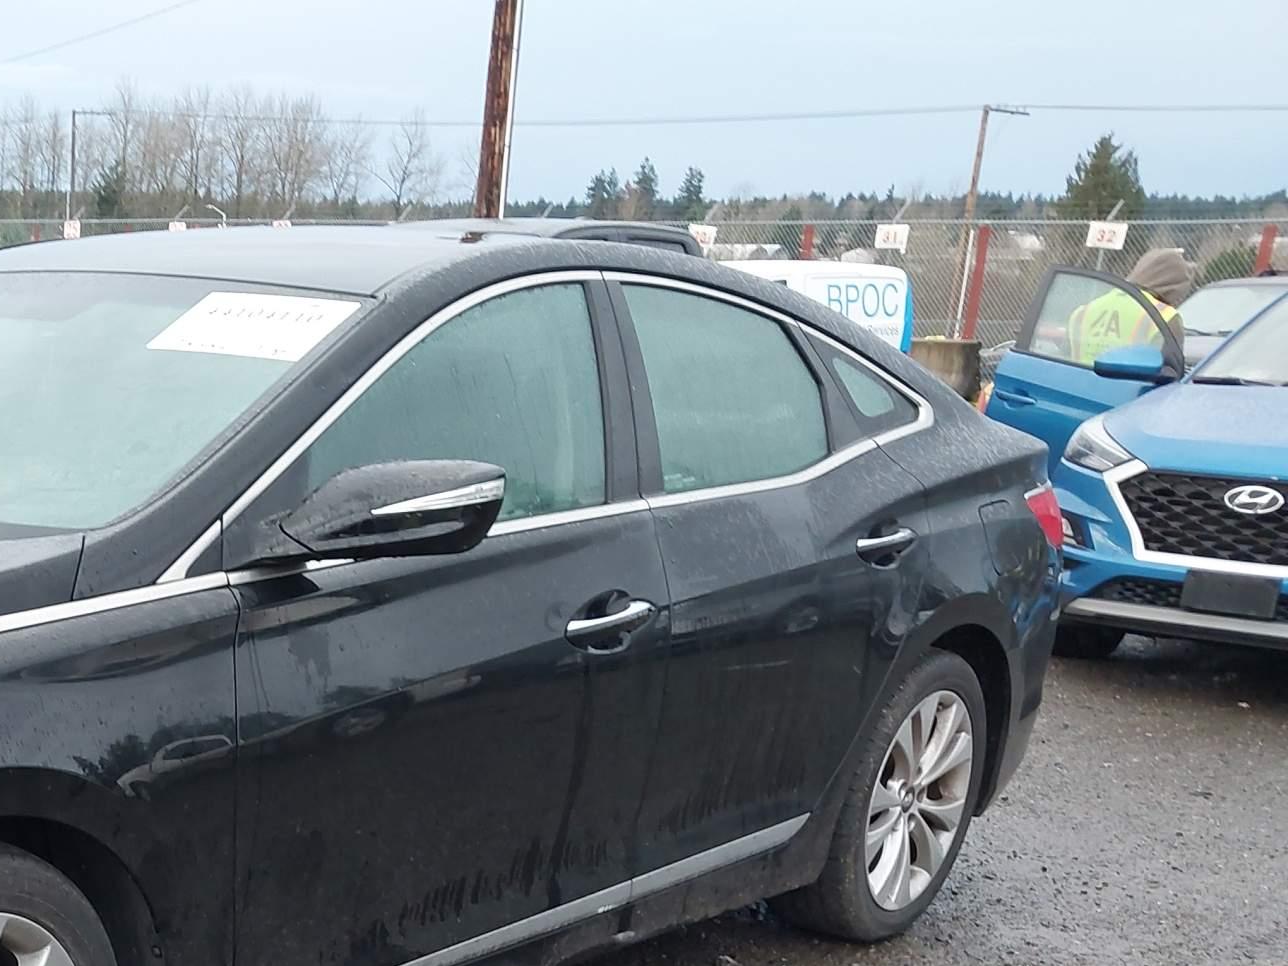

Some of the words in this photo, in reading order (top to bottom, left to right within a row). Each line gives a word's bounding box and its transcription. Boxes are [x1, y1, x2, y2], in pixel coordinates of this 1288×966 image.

[881, 231, 898, 243] 31
[1096, 228, 1117, 243] 32
[827, 283, 899, 318] BPOC
